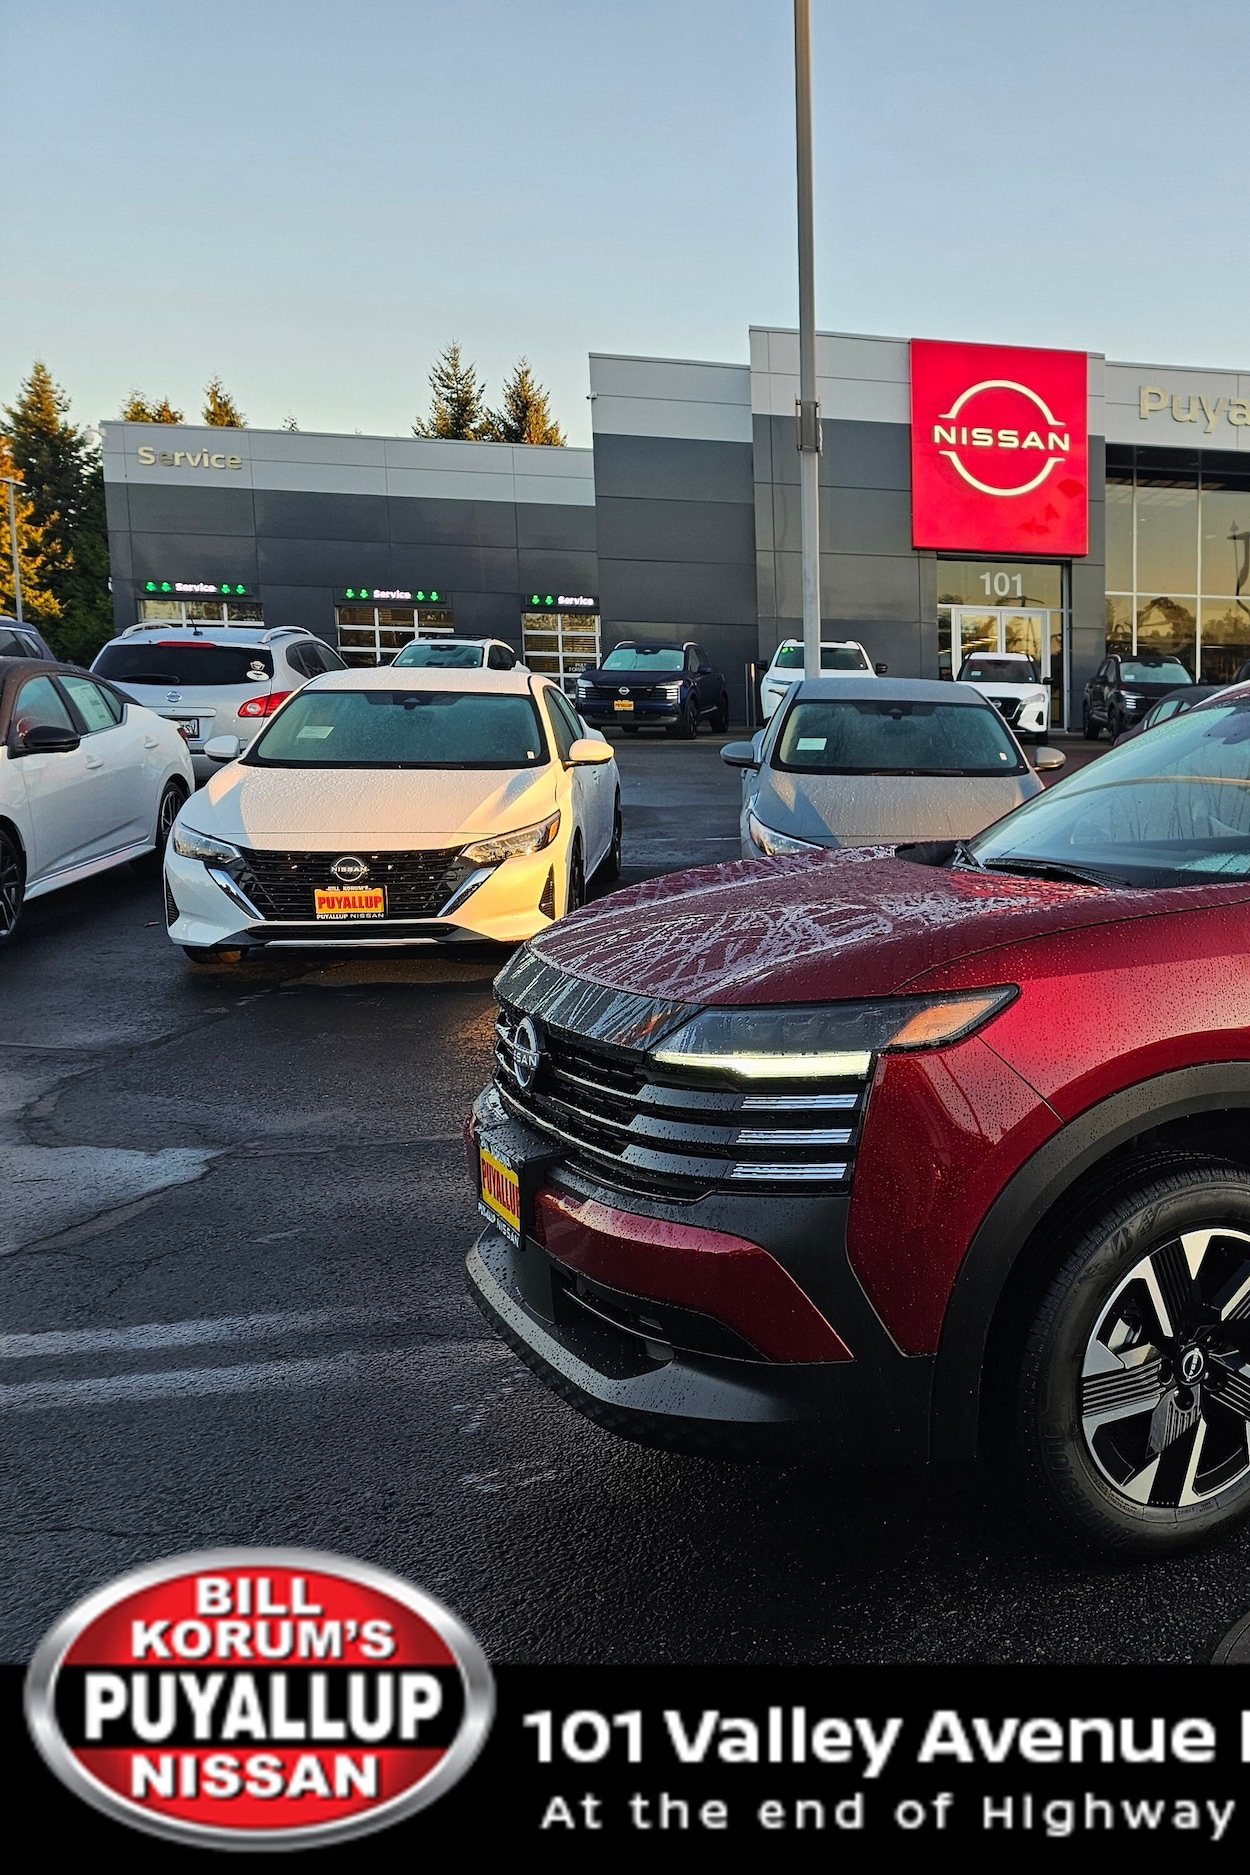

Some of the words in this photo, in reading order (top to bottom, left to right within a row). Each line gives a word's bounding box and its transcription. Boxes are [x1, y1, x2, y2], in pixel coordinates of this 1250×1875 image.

[933, 425, 1070, 452] NISSAN
[138, 446, 242, 469] Service
[175, 582, 217, 593] Service
[980, 571, 1023, 597] 101
[373, 590, 412, 599] Service
[557, 595, 594, 606] Service
[317, 895, 383, 909] PUYALLUP
